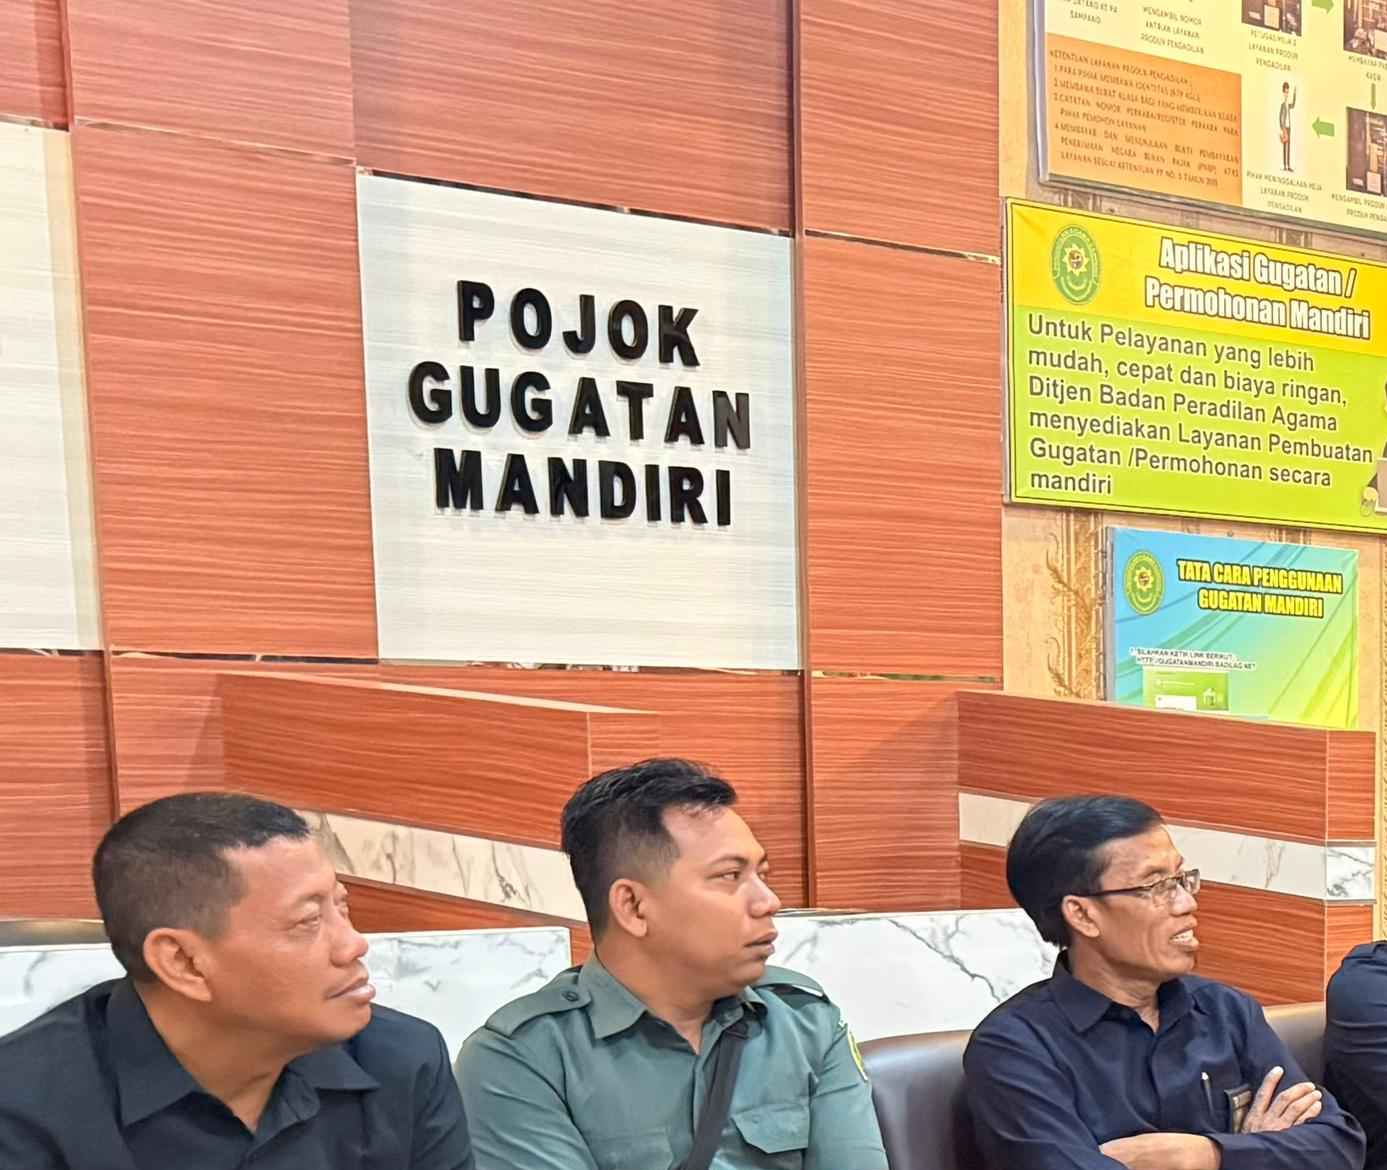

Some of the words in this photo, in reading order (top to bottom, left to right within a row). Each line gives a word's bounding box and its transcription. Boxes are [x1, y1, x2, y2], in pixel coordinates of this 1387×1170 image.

[1159, 238, 1251, 282] Aplikasi
[1253, 254, 1342, 297] Gugatan
[1344, 269, 1357, 298] /
[456, 279, 702, 368] POJOK
[1145, 277, 1286, 327] Permohonan
[1290, 300, 1371, 340] Mandiri
[1028, 314, 1092, 343] Untuk
[1100, 325, 1207, 359] Pelayanan
[1214, 342, 1261, 370] yang
[1268, 348, 1314, 372] lebih
[407, 361, 752, 451] GUGATAN
[1028, 349, 1109, 378] mudah,
[1116, 359, 1173, 385] cepat
[1181, 364, 1216, 388] dan
[1224, 369, 1275, 397] biaya
[1282, 379, 1347, 407] ringan,
[1028, 376, 1091, 404] Ditjen
[1100, 385, 1165, 412] Badan
[1173, 394, 1266, 424] Peradilan
[1272, 406, 1337, 433] Agama
[1029, 411, 1170, 443] menyediakan
[1178, 428, 1261, 453] Layanan
[1268, 435, 1373, 464] Pembuatan
[1030, 439, 1121, 468] Gugatan
[1128, 448, 1262, 481] /Permohonan
[1269, 467, 1331, 488] secara
[433, 447, 733, 527] MANDIRI
[1030, 473, 1112, 495] mandiri
[1176, 559, 1212, 582] TATA
[1214, 563, 1250, 585] CARA
[1253, 567, 1343, 594] PENGGUNAAN
[1198, 589, 1262, 614] GUGATAN
[1264, 594, 1324, 618] MANDIRI
